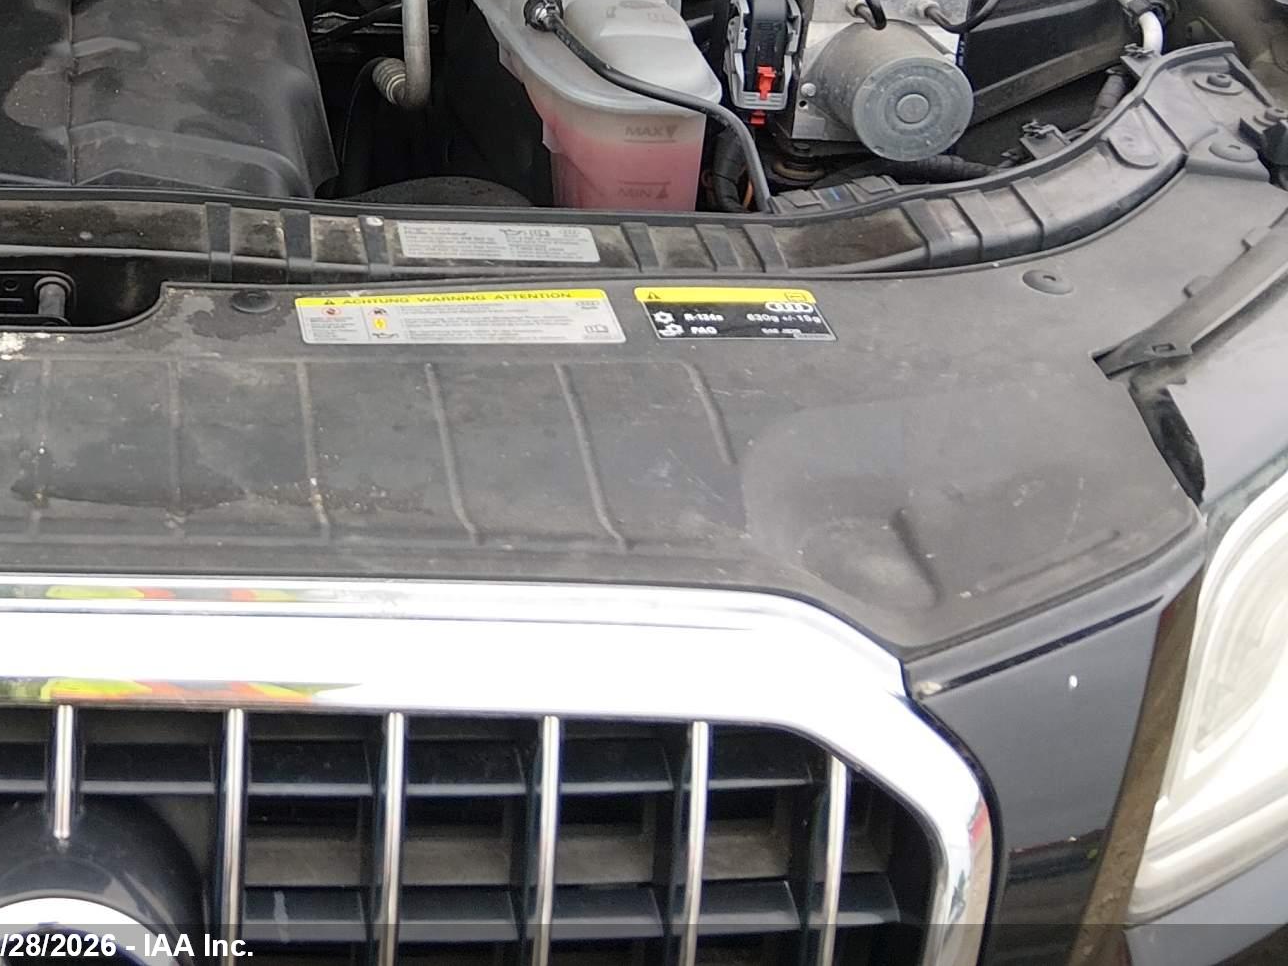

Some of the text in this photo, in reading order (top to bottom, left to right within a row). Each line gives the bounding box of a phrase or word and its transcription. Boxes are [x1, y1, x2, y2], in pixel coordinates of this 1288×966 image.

[624, 125, 663, 137] MAX
[617, 187, 652, 199] MIN
[343, 291, 572, 305] ACHTUNG WARNING ATTENTION
